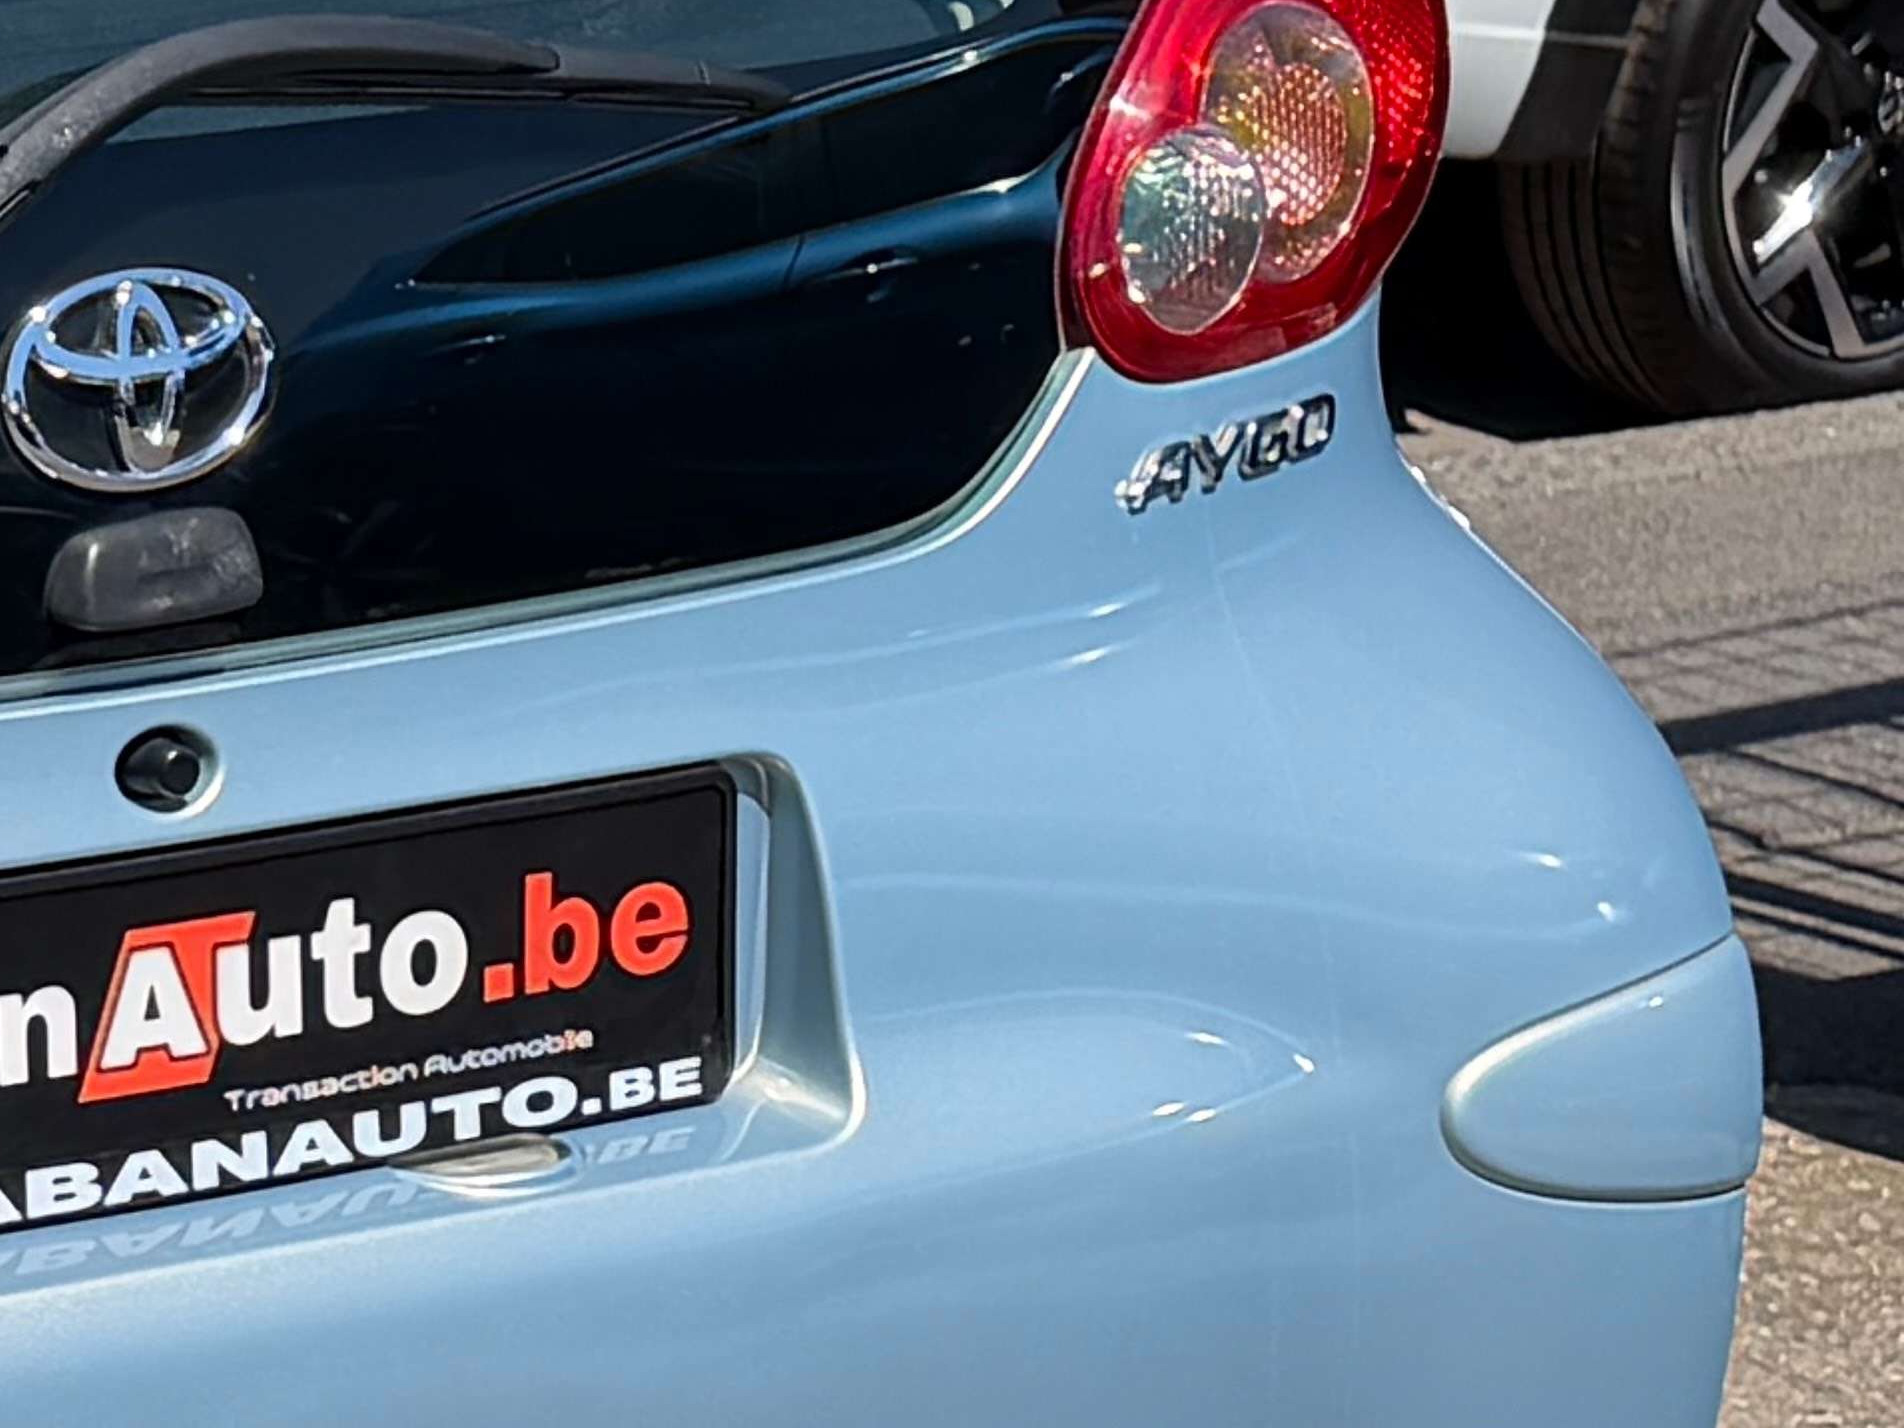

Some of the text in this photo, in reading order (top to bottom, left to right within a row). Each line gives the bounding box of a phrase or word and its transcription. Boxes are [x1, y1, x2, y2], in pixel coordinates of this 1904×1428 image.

[1113, 393, 1337, 516] AYGO
[223, 1028, 594, 1113] Transaction Automobile
